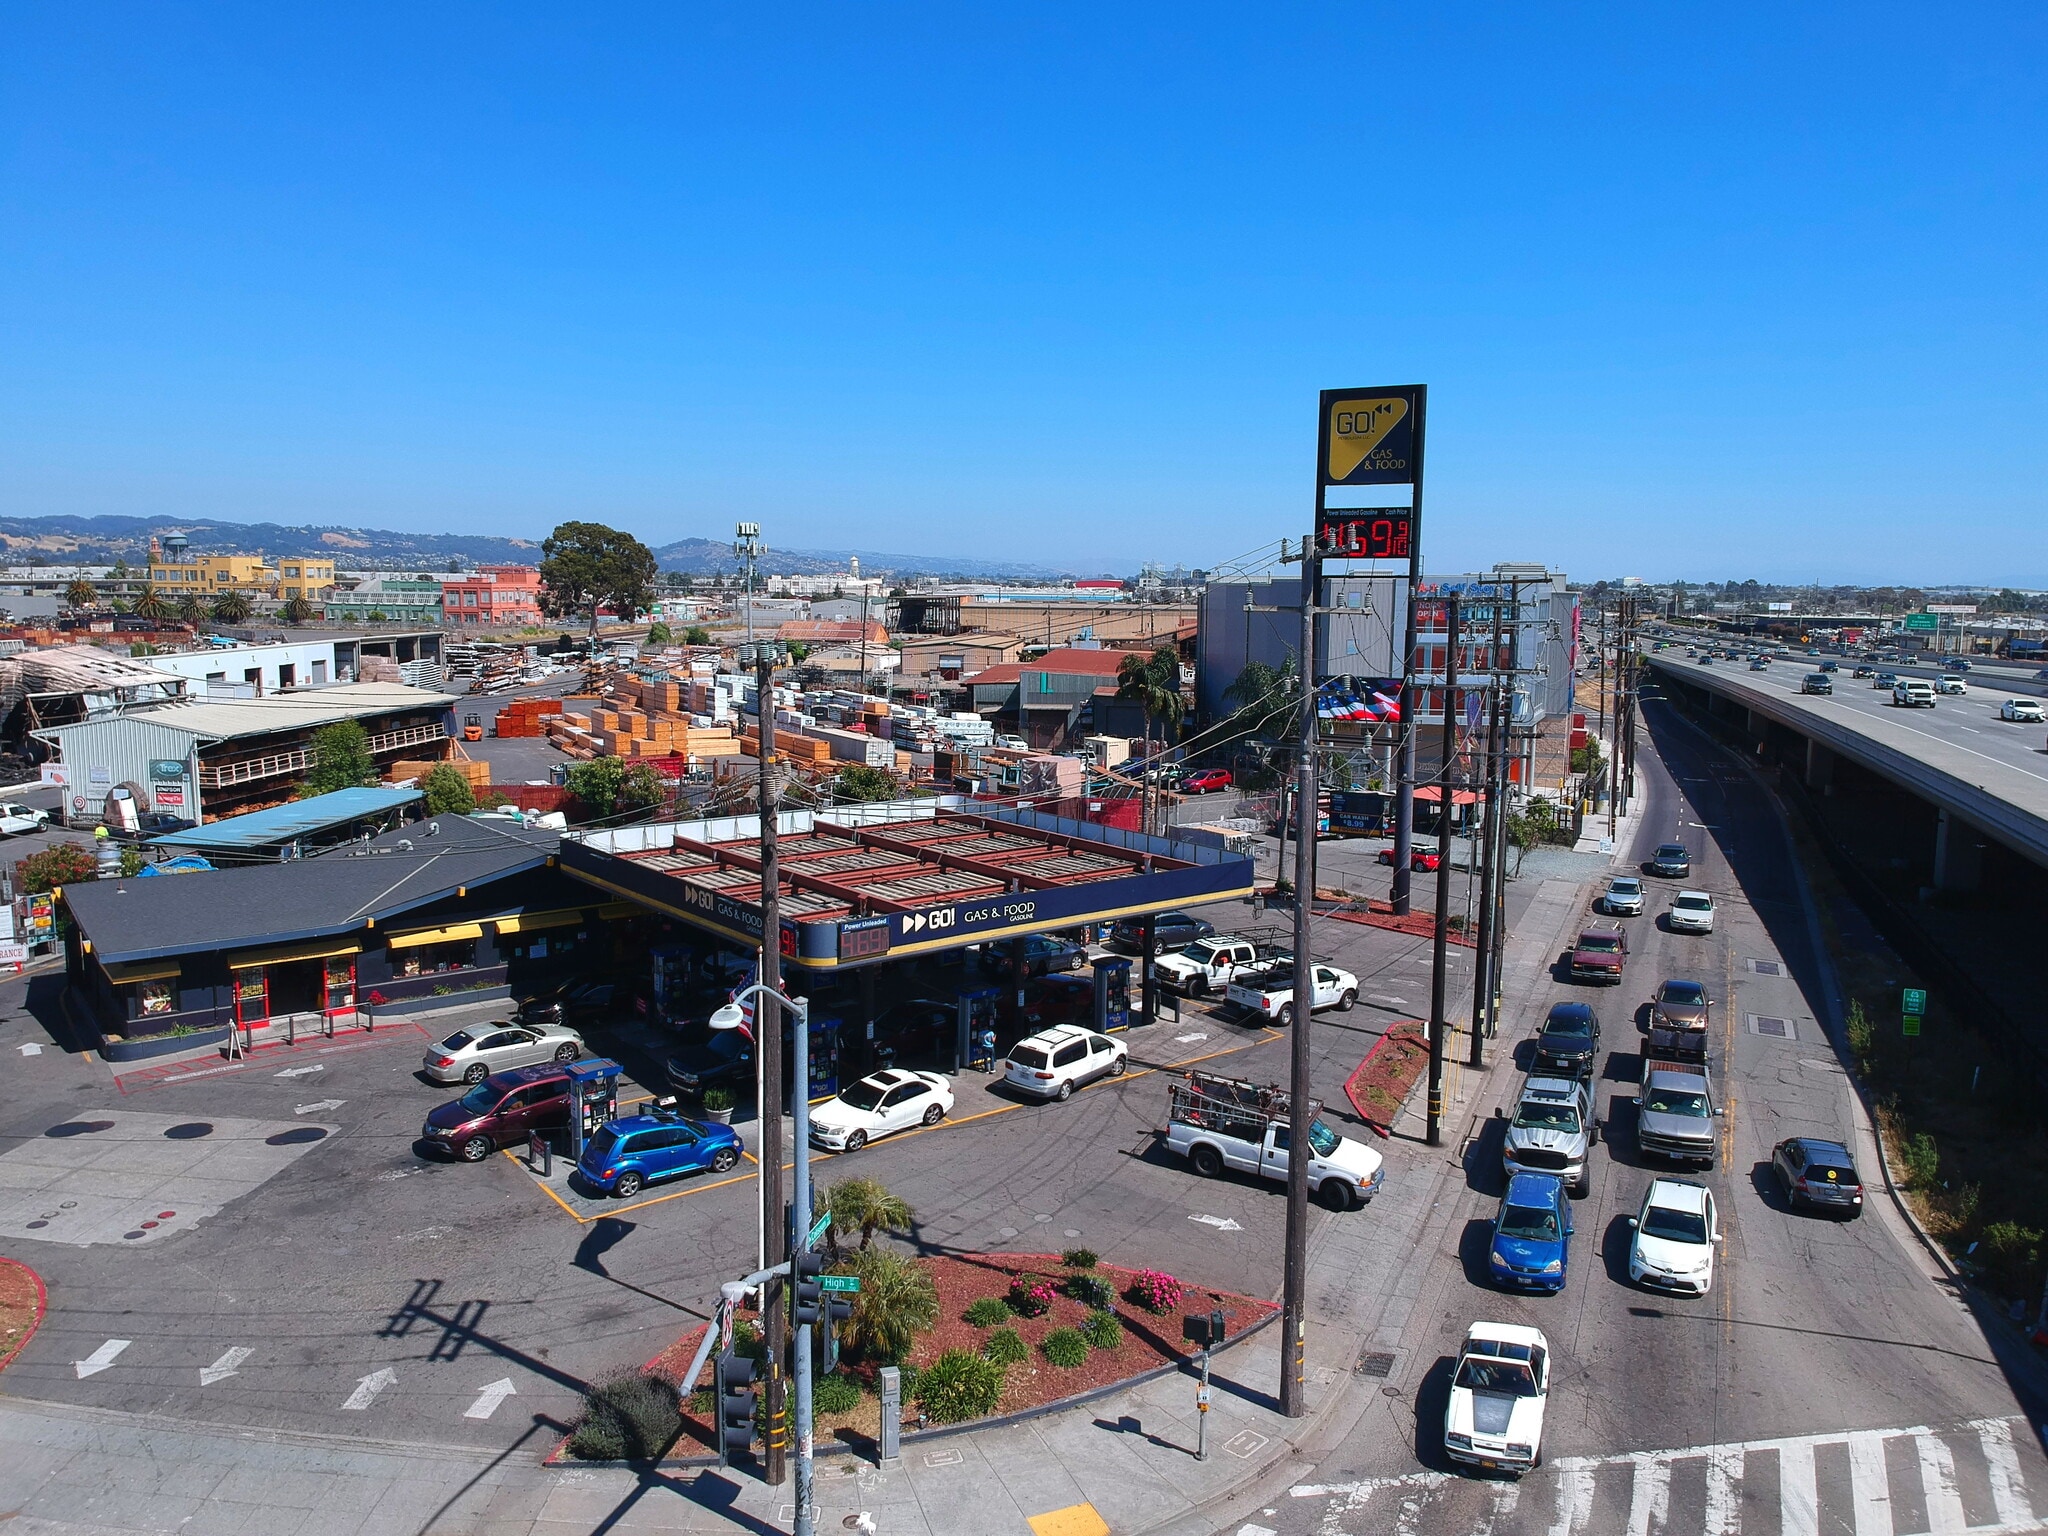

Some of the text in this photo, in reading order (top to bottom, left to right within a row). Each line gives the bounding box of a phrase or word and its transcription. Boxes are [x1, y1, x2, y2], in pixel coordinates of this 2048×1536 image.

[1336, 410, 1376, 435] GO!
[1370, 449, 1393, 460] GAS
[1364, 460, 1406, 470] & FOOD
[1442, 583, 1466, 592] Self
[160, 763, 180, 772] Trex
[698, 890, 714, 911] GO!
[717, 903, 733, 918] GAS
[733, 908, 741, 921] &
[741, 911, 763, 928] FOOD
[929, 902, 1035, 930] GO! GAS & FOOD
[1009, 912, 1034, 922] GASOLINE
[862, 918, 887, 927] Unleaded
[825, 1277, 845, 1290] High
